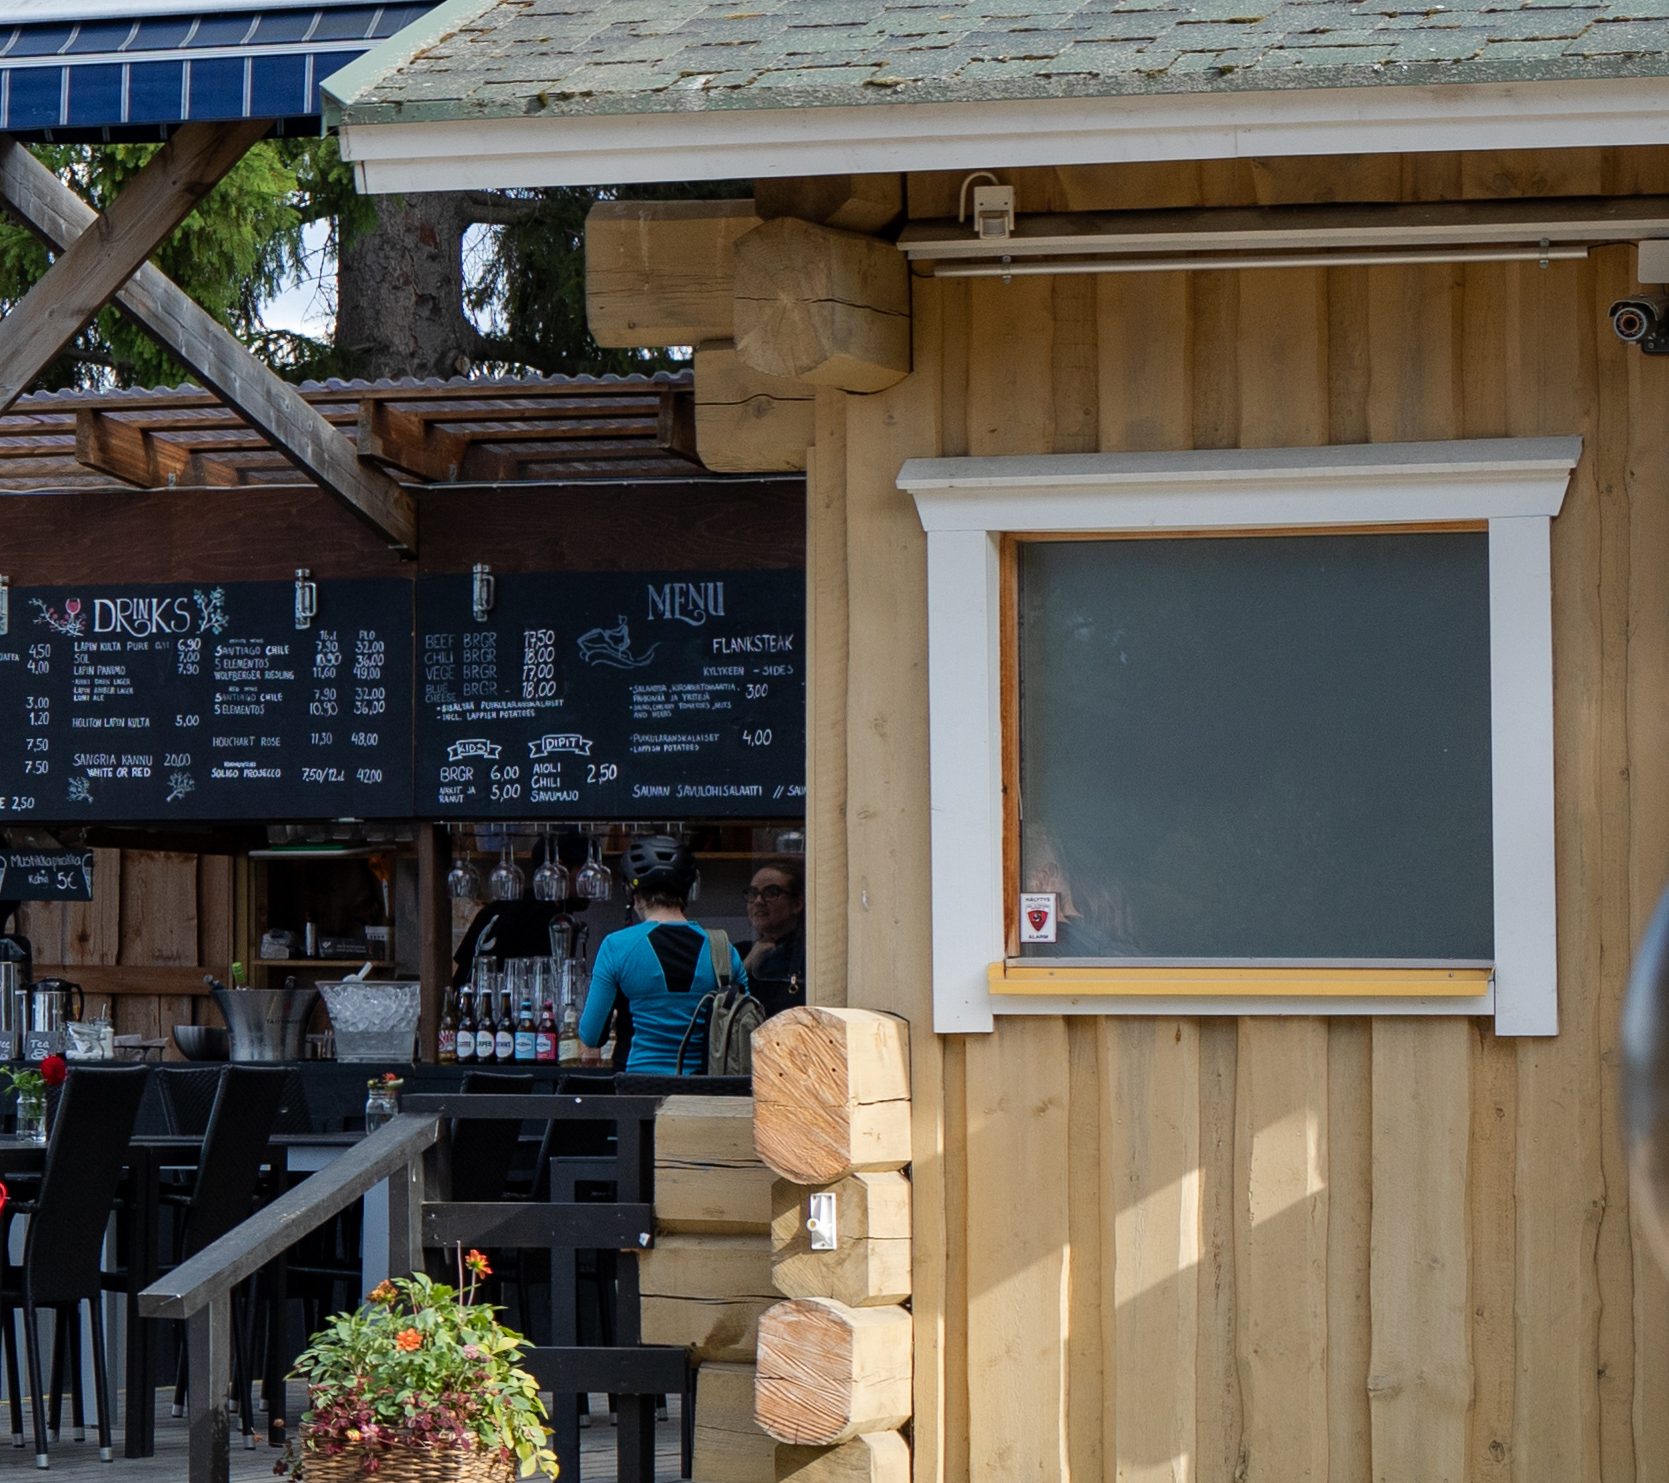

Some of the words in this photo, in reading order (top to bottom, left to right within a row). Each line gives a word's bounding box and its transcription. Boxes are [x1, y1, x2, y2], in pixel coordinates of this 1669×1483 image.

[647, 581, 725, 626] MENU
[93, 598, 191, 637] DRINKS
[425, 633, 456, 649] BEEF
[463, 631, 497, 648] BRGR
[712, 633, 794, 654] FLANKSTEAK
[74, 641, 97, 652] LAPIN
[126, 641, 149, 651] PURE
[214, 645, 261, 657] SANTIAGO
[265, 645, 290, 656] CHILE
[74, 653, 90, 664] SOL
[424, 650, 454, 664] CHILI
[463, 648, 497, 663] BRGR
[214, 658, 221, 670] 5
[223, 658, 270, 669] ELEMENTOS
[73, 665, 95, 676] LAPIN
[96, 665, 126, 675] PANIMO
[425, 665, 456, 680] VEGE
[463, 664, 497, 679] BRGR
[762, 665, 794, 676] SIDES
[425, 682, 448, 693] BLUE
[463, 680, 498, 696] BRGR
[214, 693, 256, 703] SANTIAGO
[259, 693, 283, 702] CHILE
[425, 693, 456, 703] CHEESE
[214, 704, 221, 715] 5
[222, 704, 265, 715] ELEMENTOS
[104, 717, 125, 727] LAPIN
[127, 717, 150, 727] KULTA
[212, 736, 257, 747] HOUCHART
[260, 737, 281, 747] ROSE
[545, 738, 578, 750] DIPIT
[457, 743, 486, 754] KIDS
[73, 753, 116, 767] SANGRIA
[121, 754, 153, 766] KANNU
[86, 767, 113, 777] WHITE
[116, 767, 128, 778] OR
[131, 767, 151, 777] RED
[211, 767, 239, 778] SOLIGO
[243, 768, 282, 778] PROSECCO
[440, 766, 474, 782] BRGR
[533, 762, 561, 774] AIOLI
[586, 763, 618, 784] 2,50
[531, 776, 560, 788] CHILI
[466, 785, 476, 794] JA
[632, 784, 670, 798] SAUNAN
[676, 784, 762, 798] SAVULOHISALAATTI
[530, 790, 579, 803] SAVUMAJO
[30, 1039, 50, 1048] Tea
